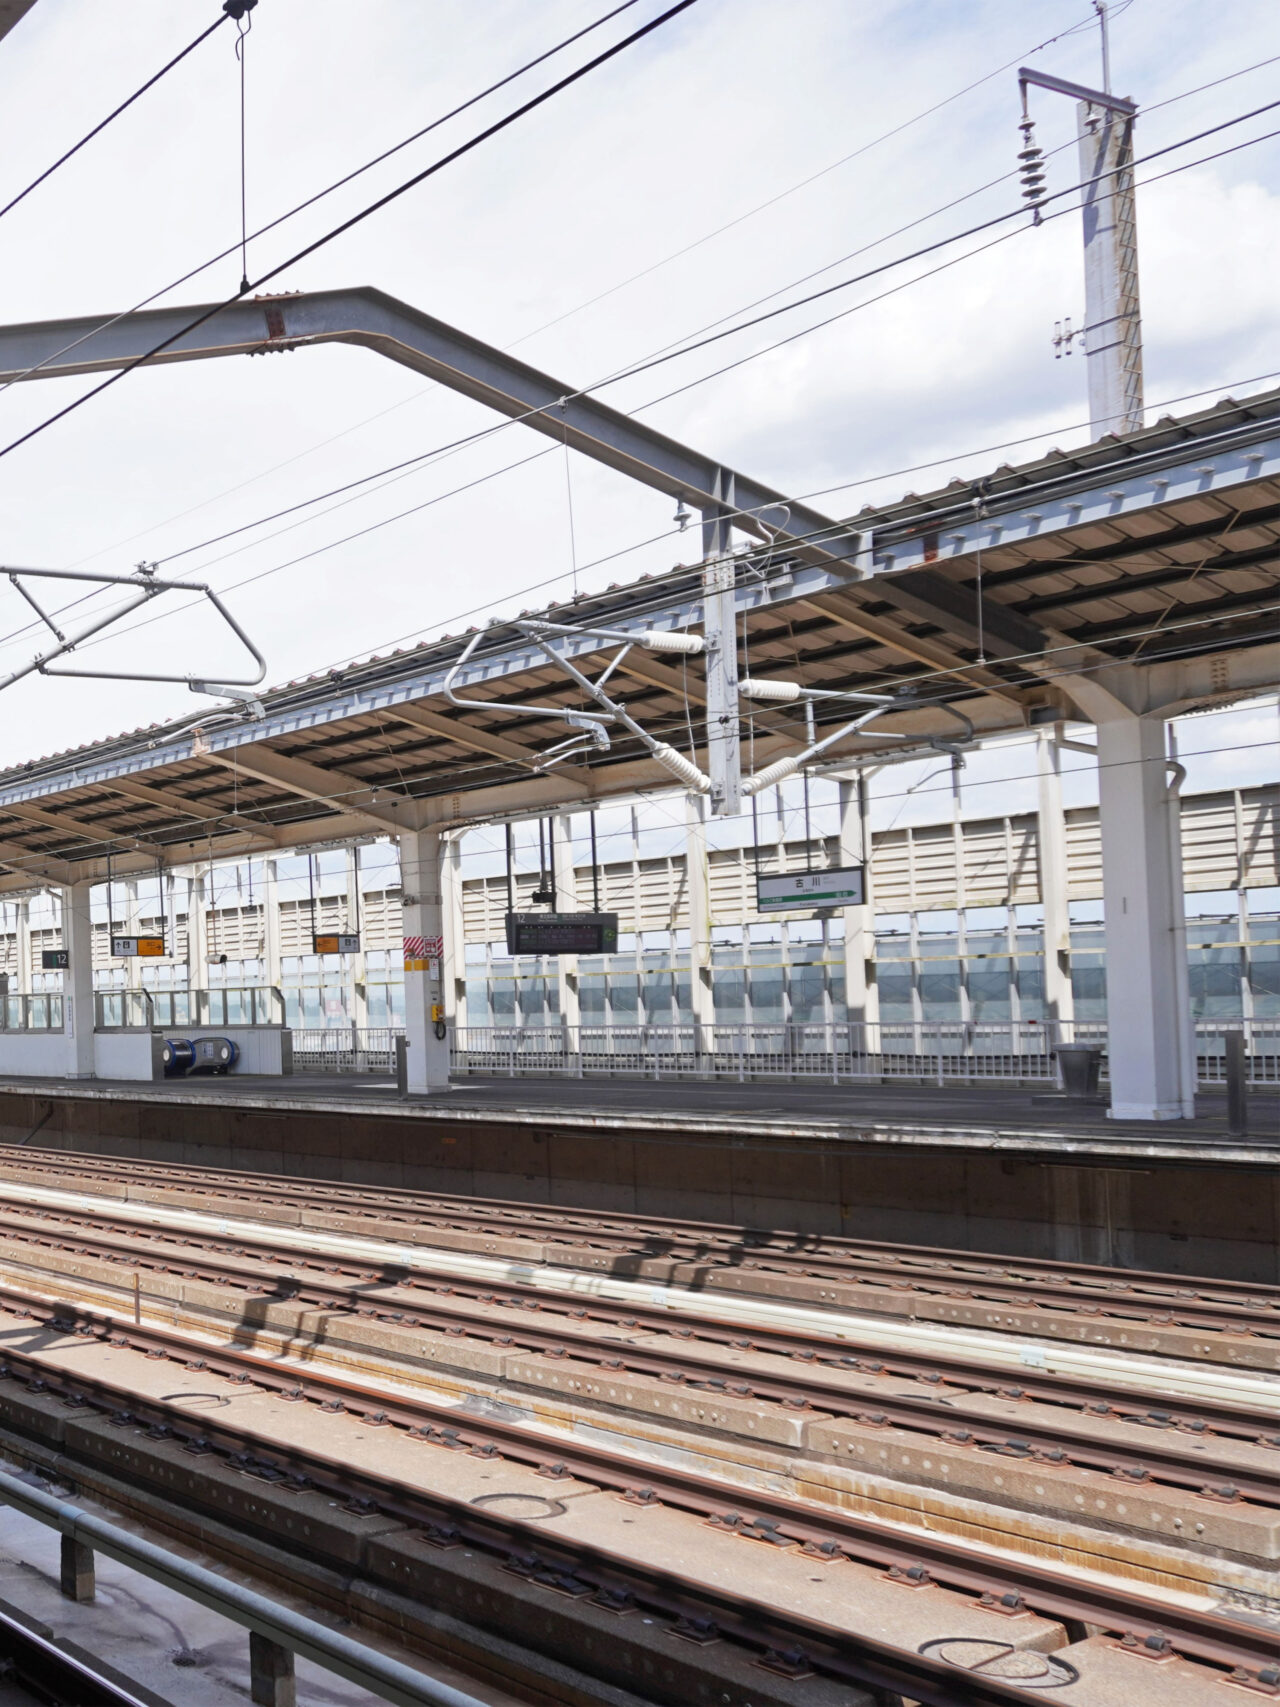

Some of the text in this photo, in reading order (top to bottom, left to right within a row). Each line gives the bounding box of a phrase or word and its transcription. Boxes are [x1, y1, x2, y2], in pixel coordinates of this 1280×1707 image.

[795, 877, 821, 888] 古川
[516, 914, 526, 923] 12
[57, 954, 67, 964] 12
